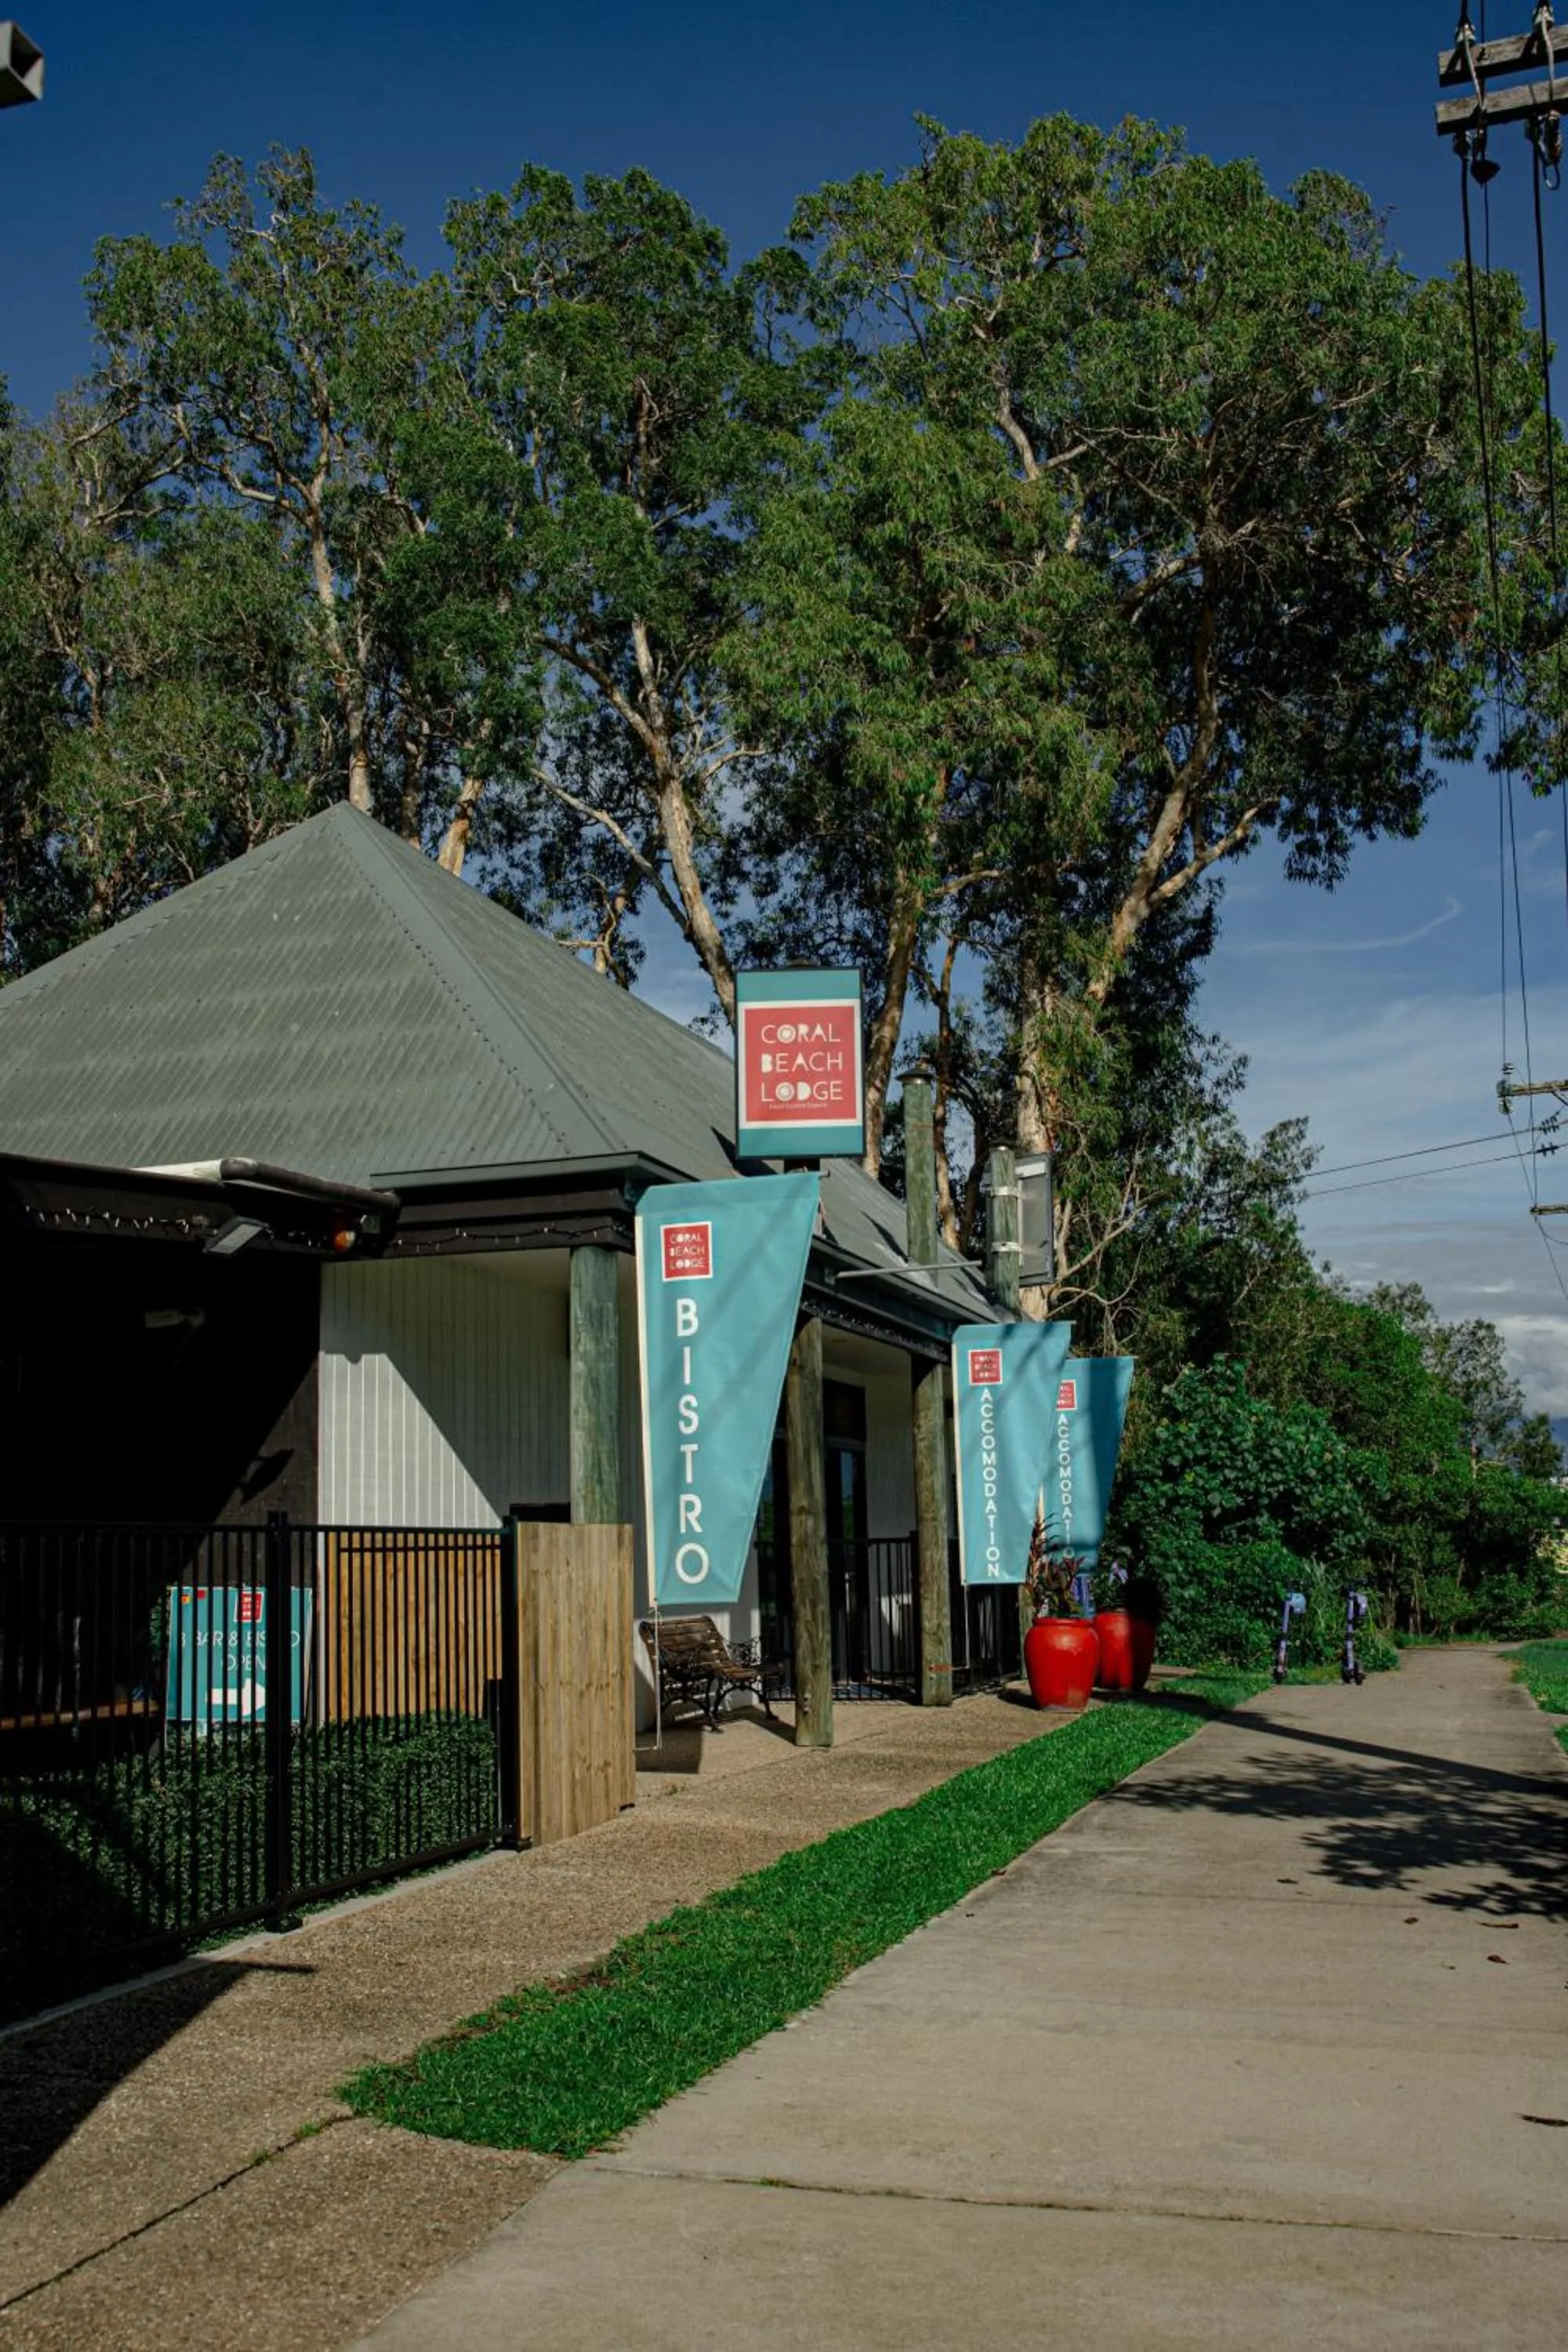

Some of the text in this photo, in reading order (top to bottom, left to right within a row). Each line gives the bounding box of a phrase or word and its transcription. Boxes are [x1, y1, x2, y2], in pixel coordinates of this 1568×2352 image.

[761, 1023, 840, 1044] CORAL
[761, 1051, 843, 1073] BEACH
[761, 1080, 843, 1102] LODGE
[670, 1232, 703, 1244] CORAL
[670, 1245, 706, 1257] BEACH
[670, 1258, 706, 1269] LODGE
[675, 1298, 709, 1584] BISTRO
[981, 1388, 1000, 1578] ACCOMODATION
[1058, 1413, 1076, 1560] ACCOMODATIO
[248, 1631, 300, 1647] BISO
